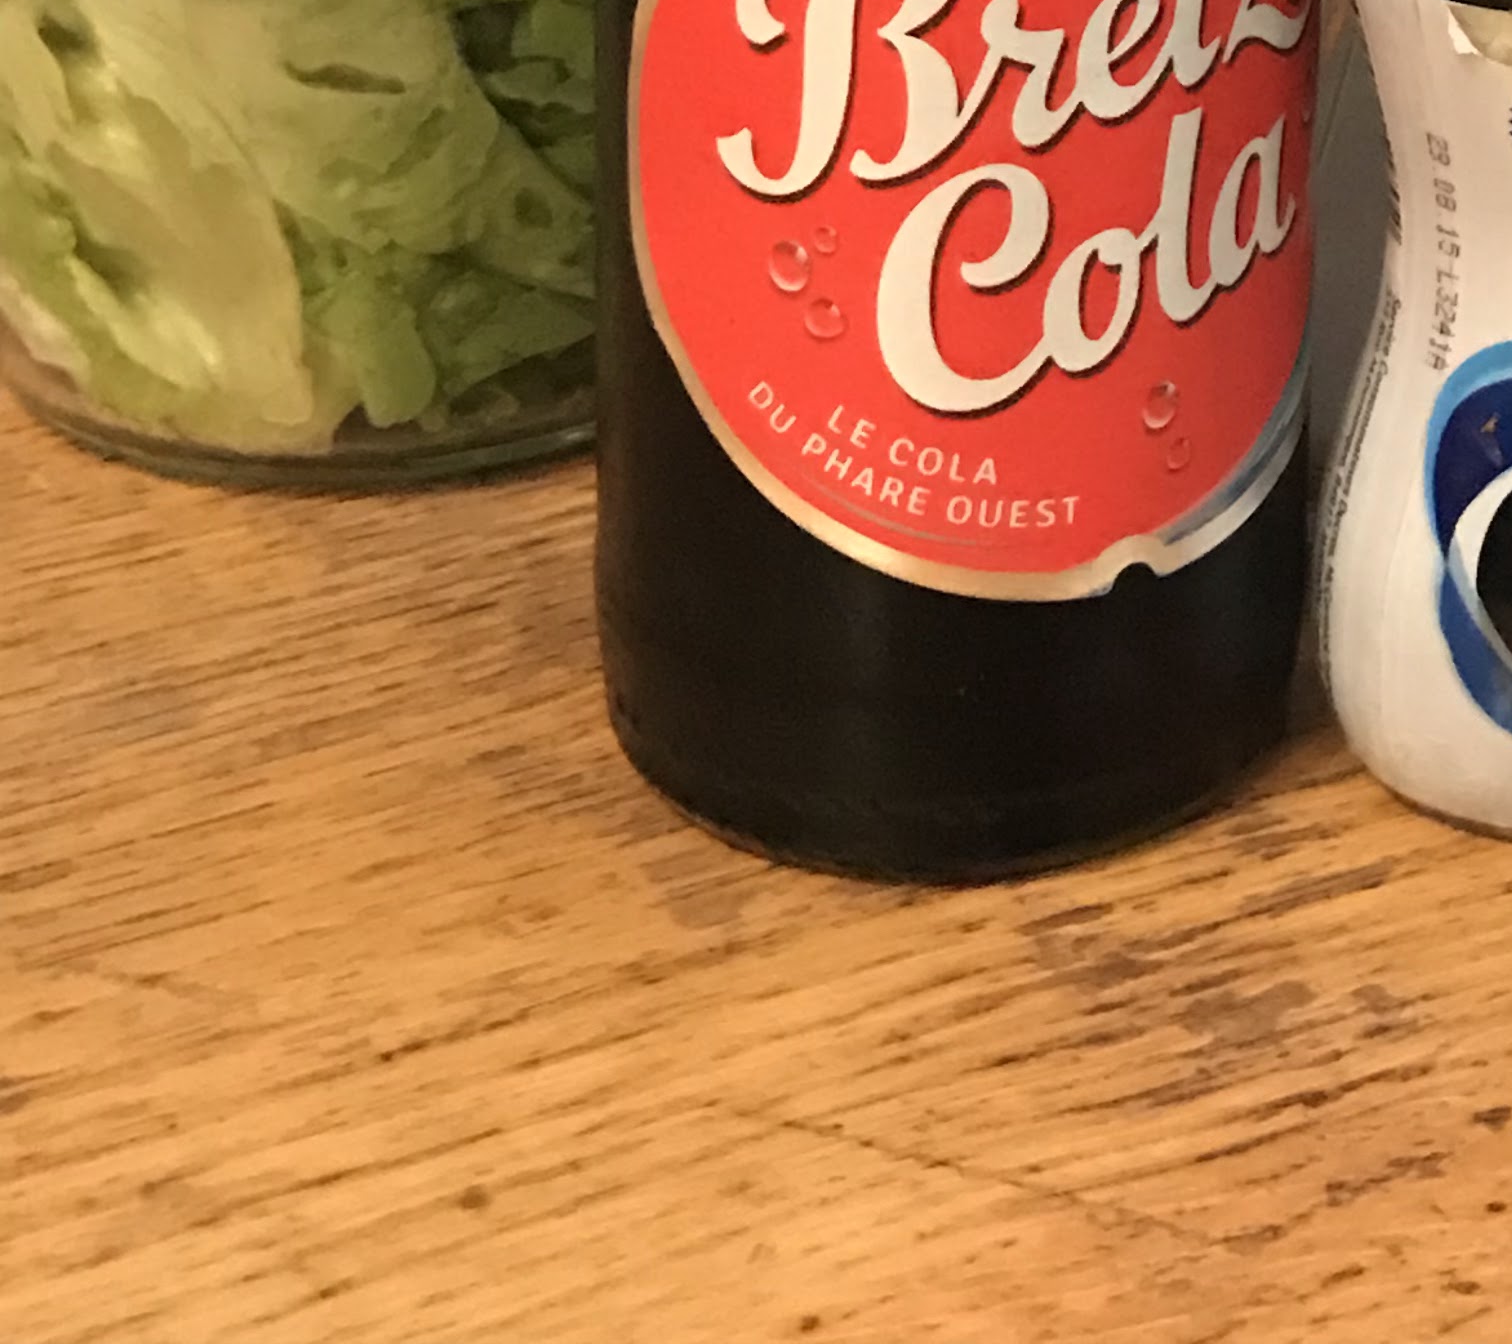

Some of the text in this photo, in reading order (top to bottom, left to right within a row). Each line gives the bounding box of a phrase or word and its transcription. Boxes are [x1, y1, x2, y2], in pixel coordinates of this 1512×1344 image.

[877, 107, 1297, 414] Cola
[747, 381, 1081, 529] DU PHARE OUEST
[828, 405, 998, 486] LE COLA
